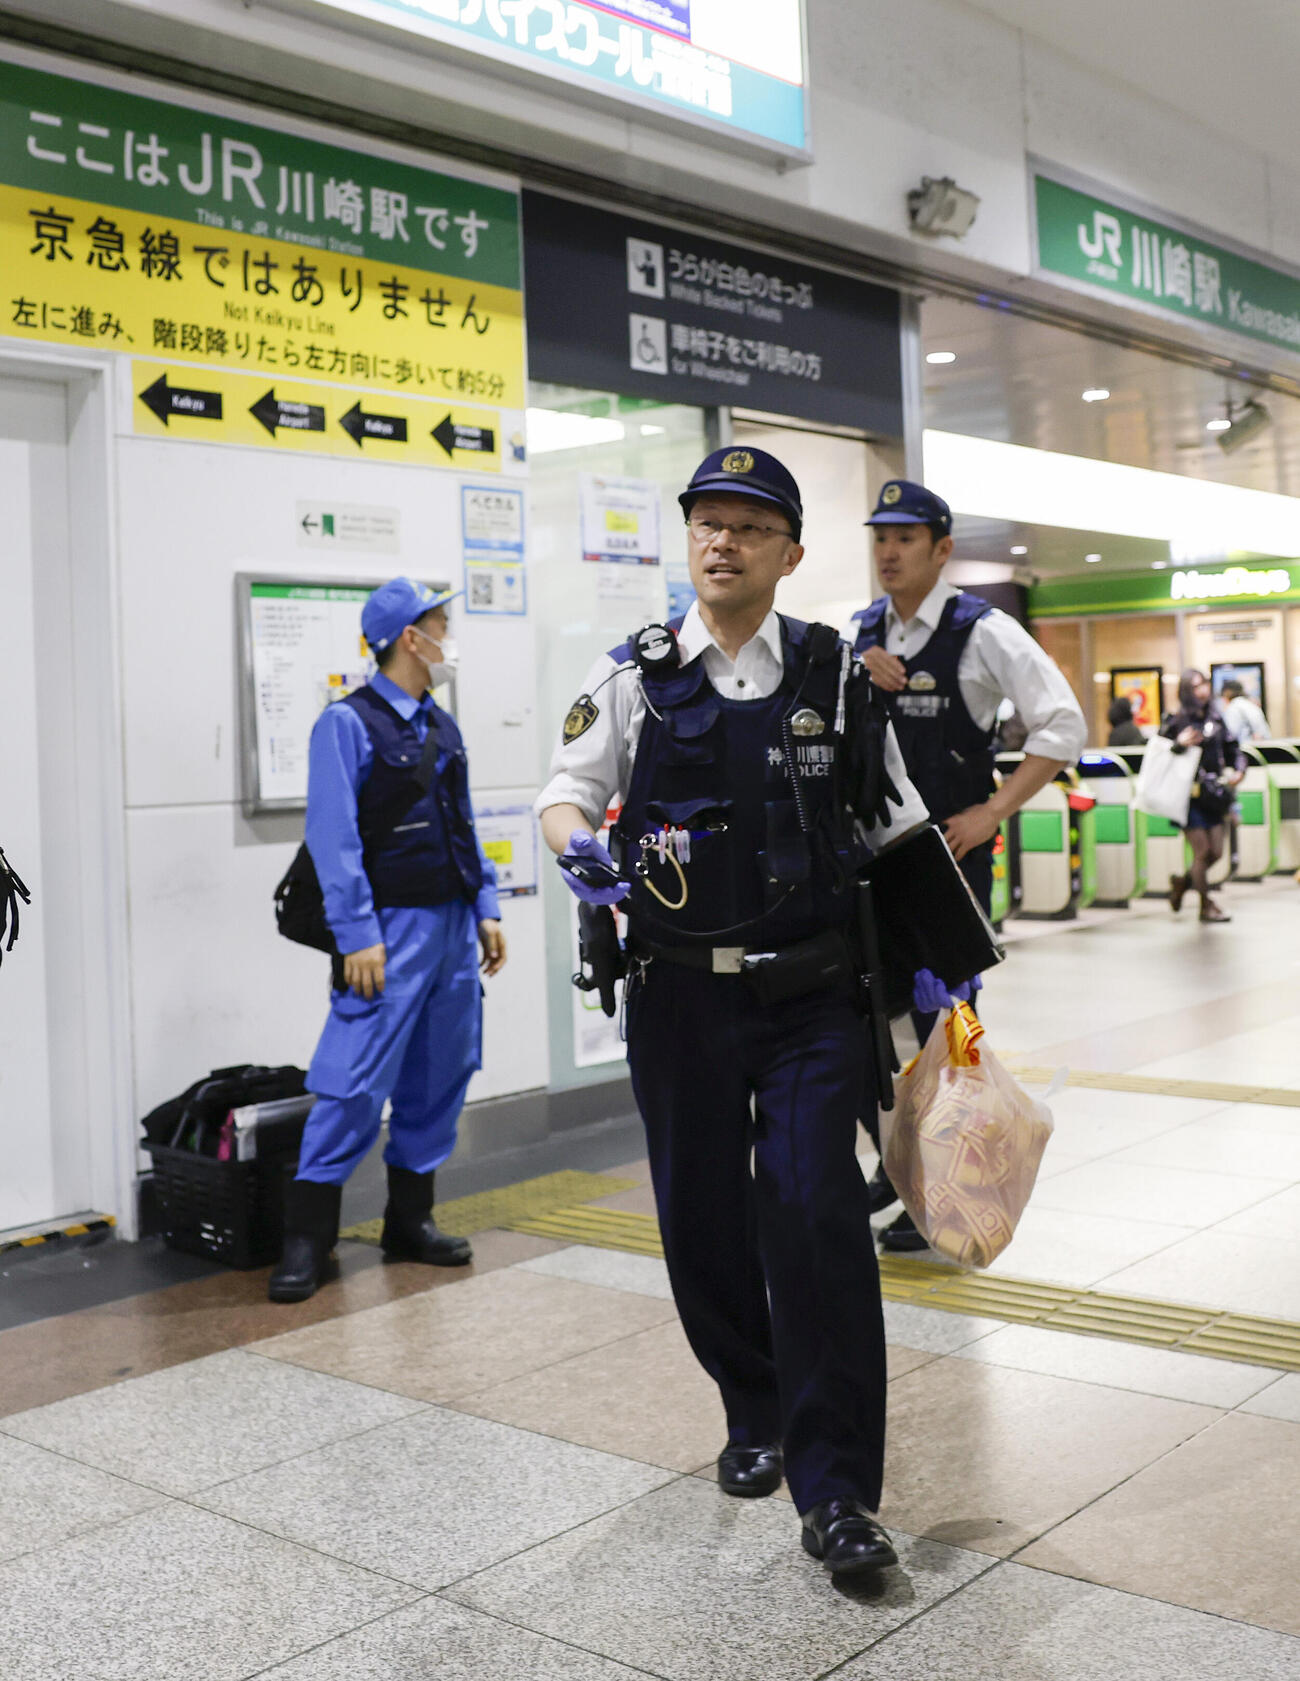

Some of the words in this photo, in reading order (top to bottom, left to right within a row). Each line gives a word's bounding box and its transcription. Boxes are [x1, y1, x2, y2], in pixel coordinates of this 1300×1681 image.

[28, 206, 491, 336] 京急線ではありません
[1077, 210, 1123, 267] JR
[1131, 225, 1224, 316] 川崎駅
[224, 301, 249, 321] Not
[254, 306, 302, 331] Keikyu
[307, 315, 335, 335] Line
